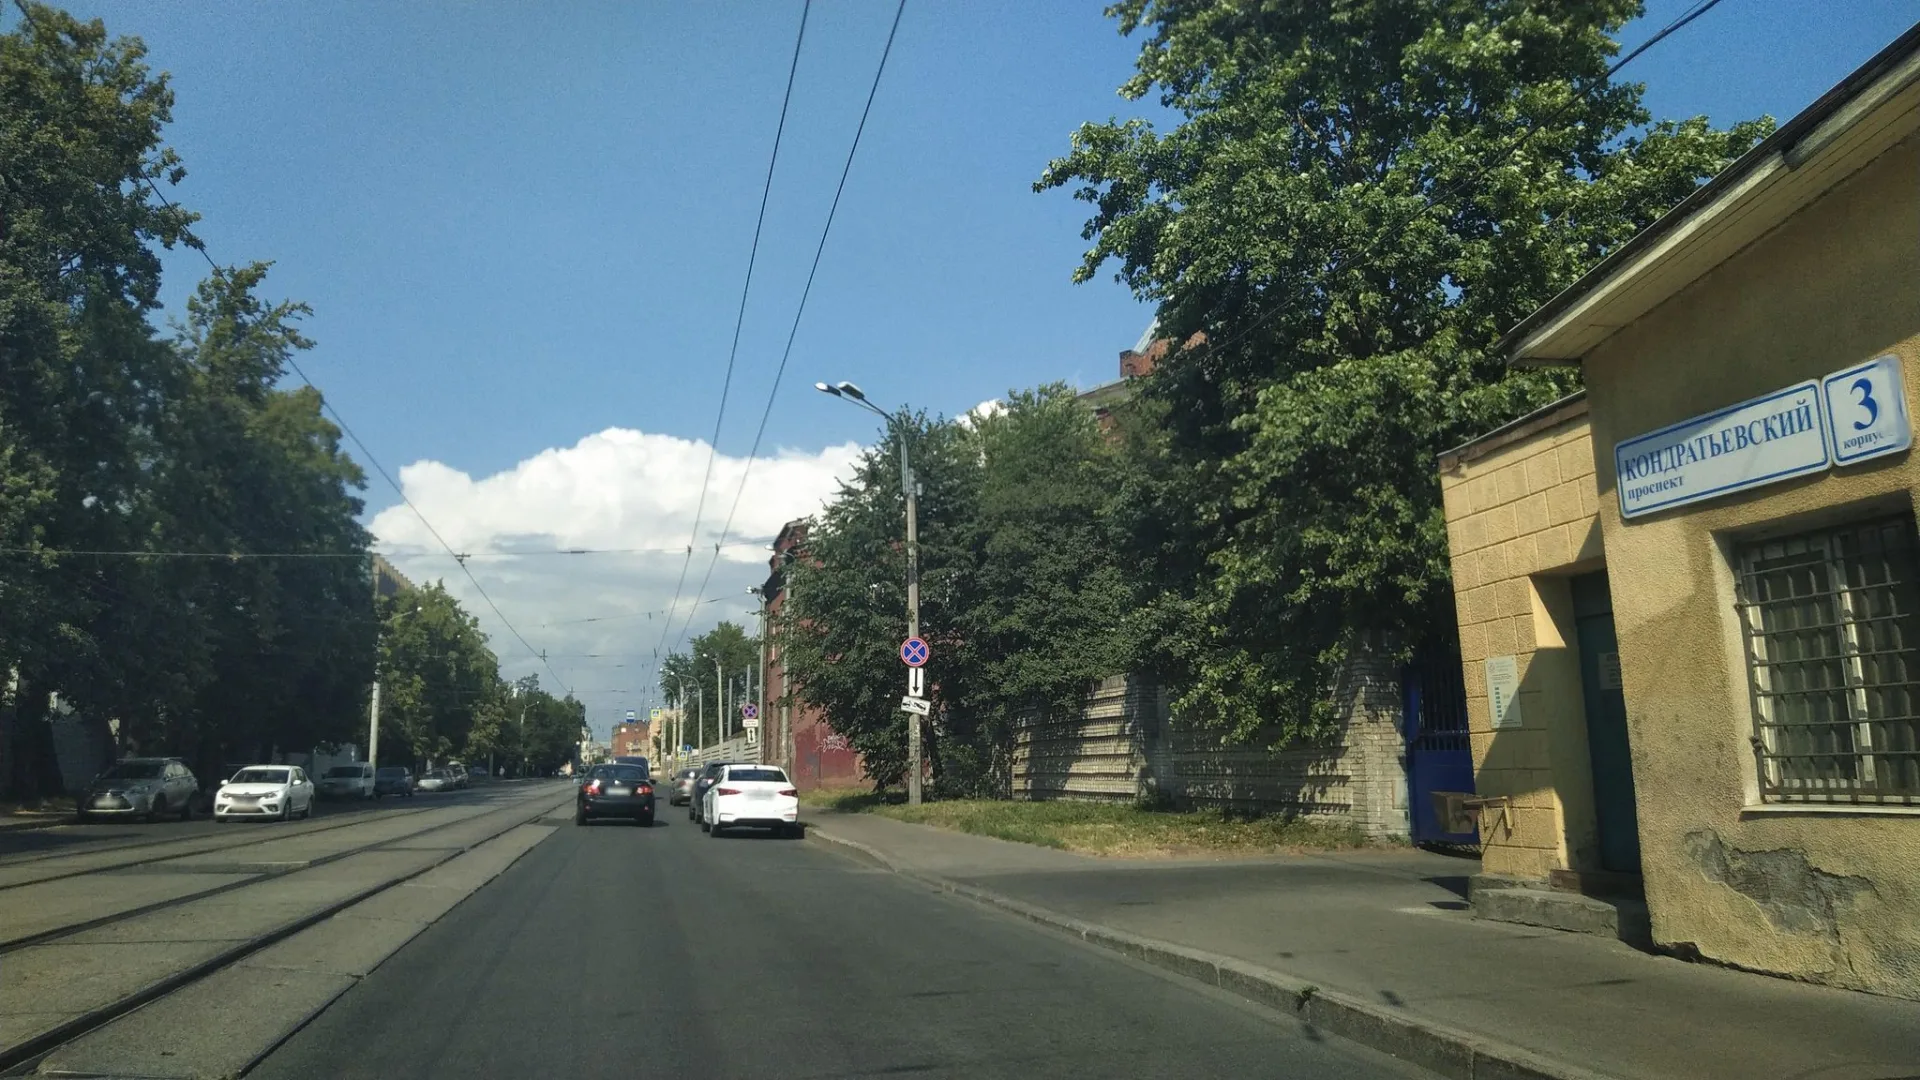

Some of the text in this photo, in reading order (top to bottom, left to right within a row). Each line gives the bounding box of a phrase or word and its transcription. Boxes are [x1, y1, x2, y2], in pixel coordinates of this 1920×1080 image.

[1850, 376, 1878, 431] 3
[1624, 399, 1813, 481] КОНДРАТЬЕВСКИЙ
[1627, 476, 1685, 502] проспект
